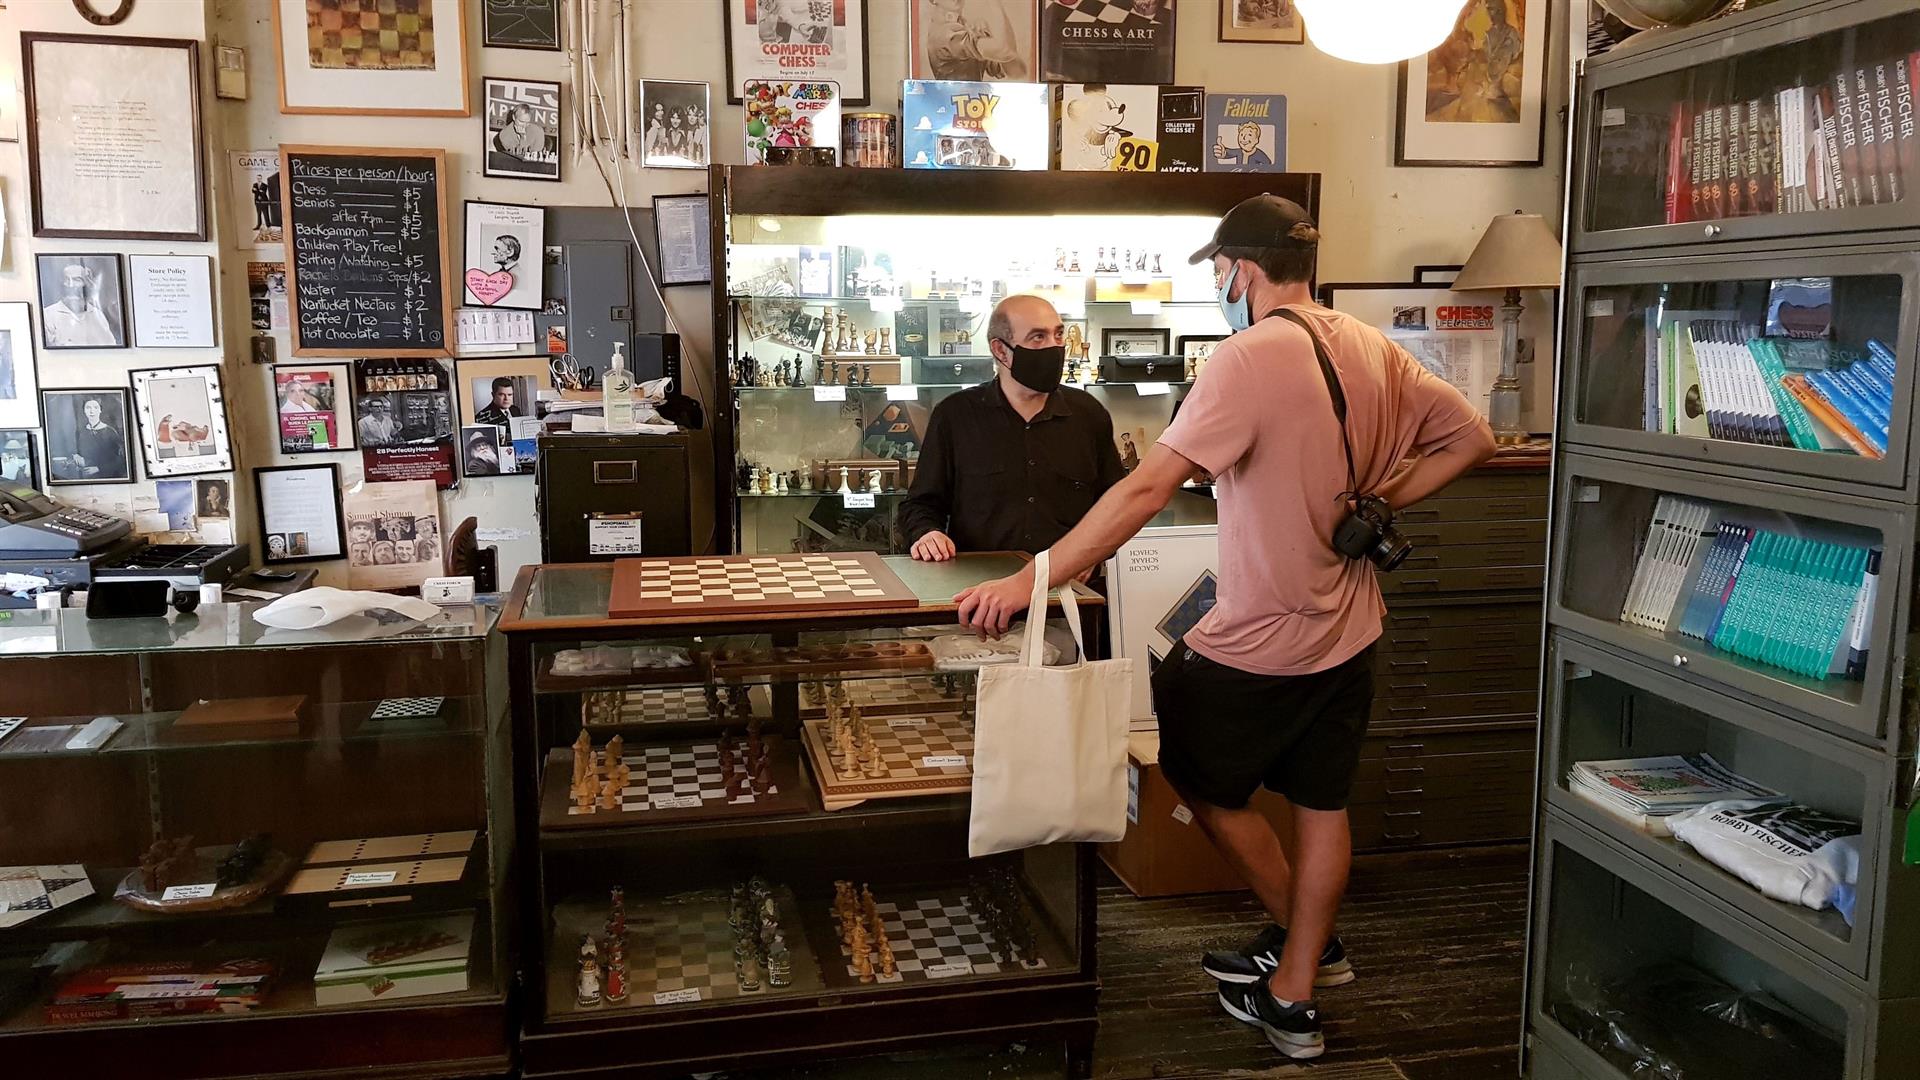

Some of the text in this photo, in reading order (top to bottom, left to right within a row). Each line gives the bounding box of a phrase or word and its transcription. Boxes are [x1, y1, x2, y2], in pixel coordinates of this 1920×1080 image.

[1062, 27, 1154, 38] CHESS & ART
[762, 44, 831, 56] COMPUTER
[778, 56, 816, 68] CHESS
[792, 89, 834, 100] MARIO
[800, 83, 830, 91] SUPER
[795, 102, 829, 110] CHES
[951, 94, 1000, 118] TOY
[1224, 98, 1270, 118] Fallout
[1856, 70, 1874, 145] BOBBY FISCHER
[1876, 65, 1894, 143] BOBBY FISCHER
[1896, 60, 1913, 139] BOBBY FISCHER
[1730, 106, 1739, 136] BOBBY
[1750, 100, 1758, 131] BOBBY
[1837, 74, 1856, 149] BOBBY FISCHER
[1704, 110, 1712, 140] BOBBY
[1713, 108, 1721, 139] BOBBY
[1824, 116, 1837, 138] YOUR
[238, 158, 268, 166] GAME
[1119, 142, 1151, 170] 90
[1703, 142, 1711, 180] FISCHER
[1712, 141, 1720, 180] FISCHER
[1729, 138, 1738, 177] FISCHER
[1749, 134, 1757, 174] FISCHER
[292, 159, 330, 176] Prices
[335, 168, 351, 183] per
[1692, 147, 1701, 184] FISCHER
[293, 182, 422, 200] Chess $5
[295, 197, 335, 207] Seniors
[332, 210, 422, 228] after 7pm $5
[295, 224, 420, 240] Backgammon $5
[297, 239, 402, 256] Children Play Free!
[298, 254, 335, 270] Sitting
[404, 255, 423, 268] $5
[300, 284, 336, 296] Water
[300, 298, 350, 311] Nantucket
[355, 298, 396, 310] Nectars
[1436, 306, 1494, 320] CHESS
[302, 313, 341, 325] Coffee
[352, 314, 377, 325] Tea
[302, 328, 322, 339] Hot
[326, 328, 380, 339] Chocolate
[346, 511, 378, 520] Samuel
[1710, 814, 1807, 856] BOBBY FISCHER
[1253, 951, 1279, 972] N
[1244, 994, 1259, 1016] N
